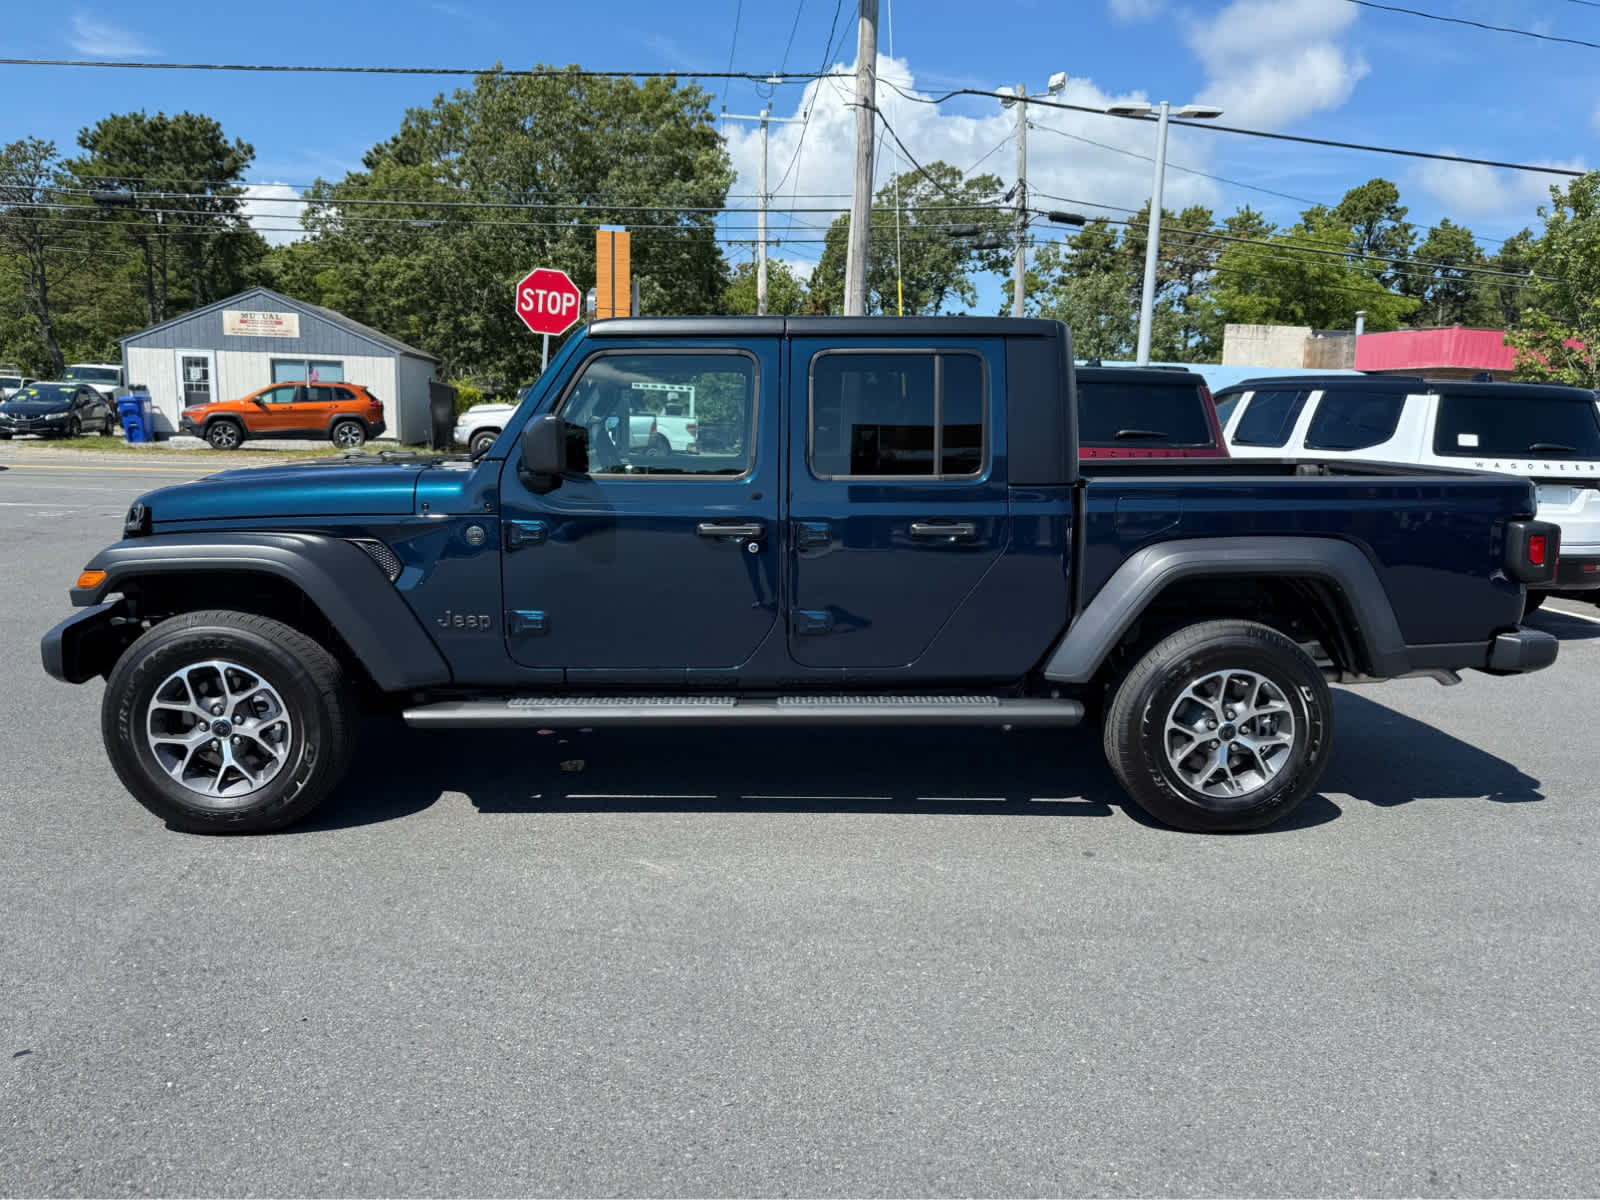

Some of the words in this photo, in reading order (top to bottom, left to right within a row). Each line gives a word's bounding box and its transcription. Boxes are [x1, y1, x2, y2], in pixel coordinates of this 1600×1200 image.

[521, 288, 576, 316] STOP
[1475, 461, 1595, 471] WAGONEER
[437, 609, 491, 632] Jeep
